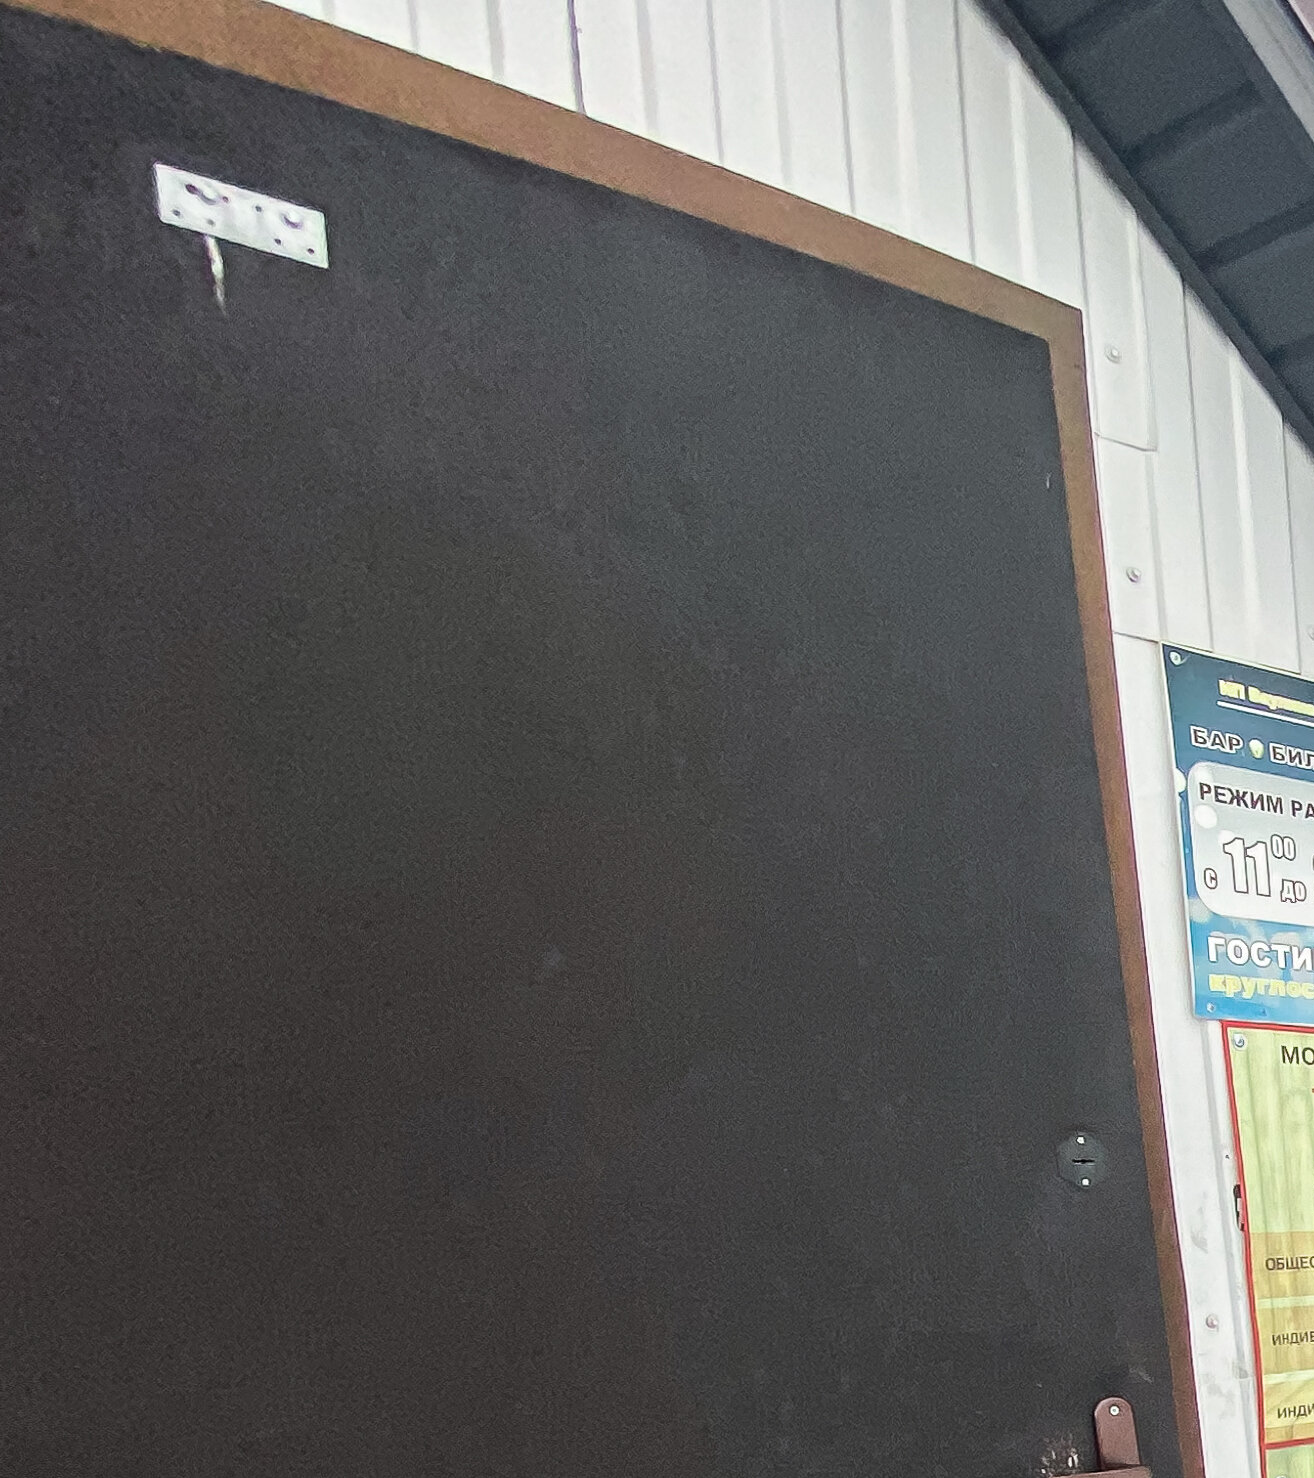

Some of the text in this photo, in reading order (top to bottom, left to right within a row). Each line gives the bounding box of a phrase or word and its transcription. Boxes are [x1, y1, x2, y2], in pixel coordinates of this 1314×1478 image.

[1190, 725, 1243, 754] БАР
[1199, 782, 1284, 815] РЕЖИМ
[1280, 878, 1307, 904] до
